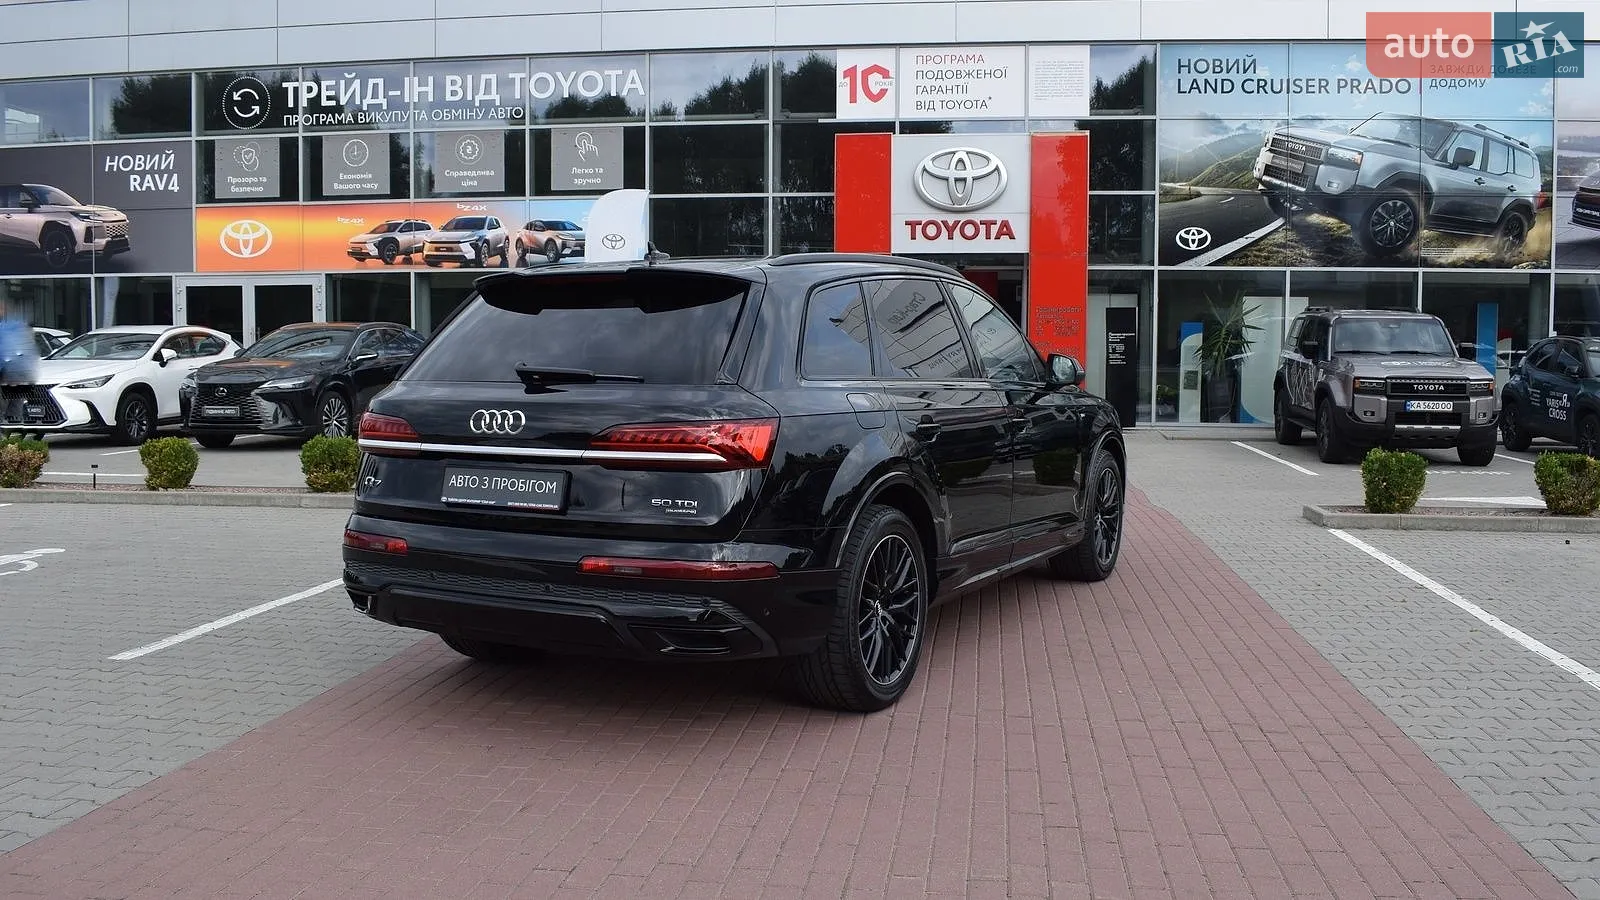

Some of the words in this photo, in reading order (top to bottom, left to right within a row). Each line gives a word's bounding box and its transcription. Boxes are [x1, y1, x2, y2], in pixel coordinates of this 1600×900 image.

[915, 54, 985, 65] ПРОГРАМА
[1177, 54, 1257, 75] НОВИЙ
[915, 66, 1008, 82] ПОДОВЖЕНОЇ
[1429, 64, 1485, 75] ЗАВЖДИ
[1489, 64, 1537, 76] ДОВЕЗЕ
[281, 72, 434, 111] ТРЕЙД-ІН
[445, 73, 501, 107] ВІД
[508, 69, 646, 99] TOYOTA
[915, 82, 969, 96] ГАРАНТІЇ
[1177, 78, 1235, 95] LAND
[1240, 78, 1330, 95] CRUISER
[1336, 78, 1412, 95] PRADO
[1429, 78, 1487, 90] ДОДОМУ
[915, 100, 936, 112] ВІД
[283, 113, 354, 127] ПРОГРАМА
[357, 110, 410, 124] ВИКУПУ
[412, 110, 428, 122] ТА
[431, 107, 486, 121] ОБМІНУ
[488, 106, 524, 120] АВТО
[1285, 141, 1306, 151] TOYOTA
[104, 149, 175, 172] НОВИЙ
[339, 172, 372, 180] Економія
[444, 169, 495, 178] Справедлива
[571, 167, 594, 175] Легко
[129, 173, 180, 193] RAV4
[227, 176, 258, 184] Прозоро
[333, 182, 361, 190] Вашого
[361, 182, 378, 190] часу
[461, 178, 478, 188] ціна
[573, 177, 601, 185] зручно
[230, 184, 264, 193] безпечно
[905, 219, 1015, 241] TOYOTA
[1549, 408, 1567, 421] CROSS
[364, 476, 382, 486] Q7
[448, 474, 479, 488] АВТО
[491, 477, 557, 494] ПРОБІГОМ
[651, 498, 672, 507] 50
[675, 499, 698, 508] TDI
